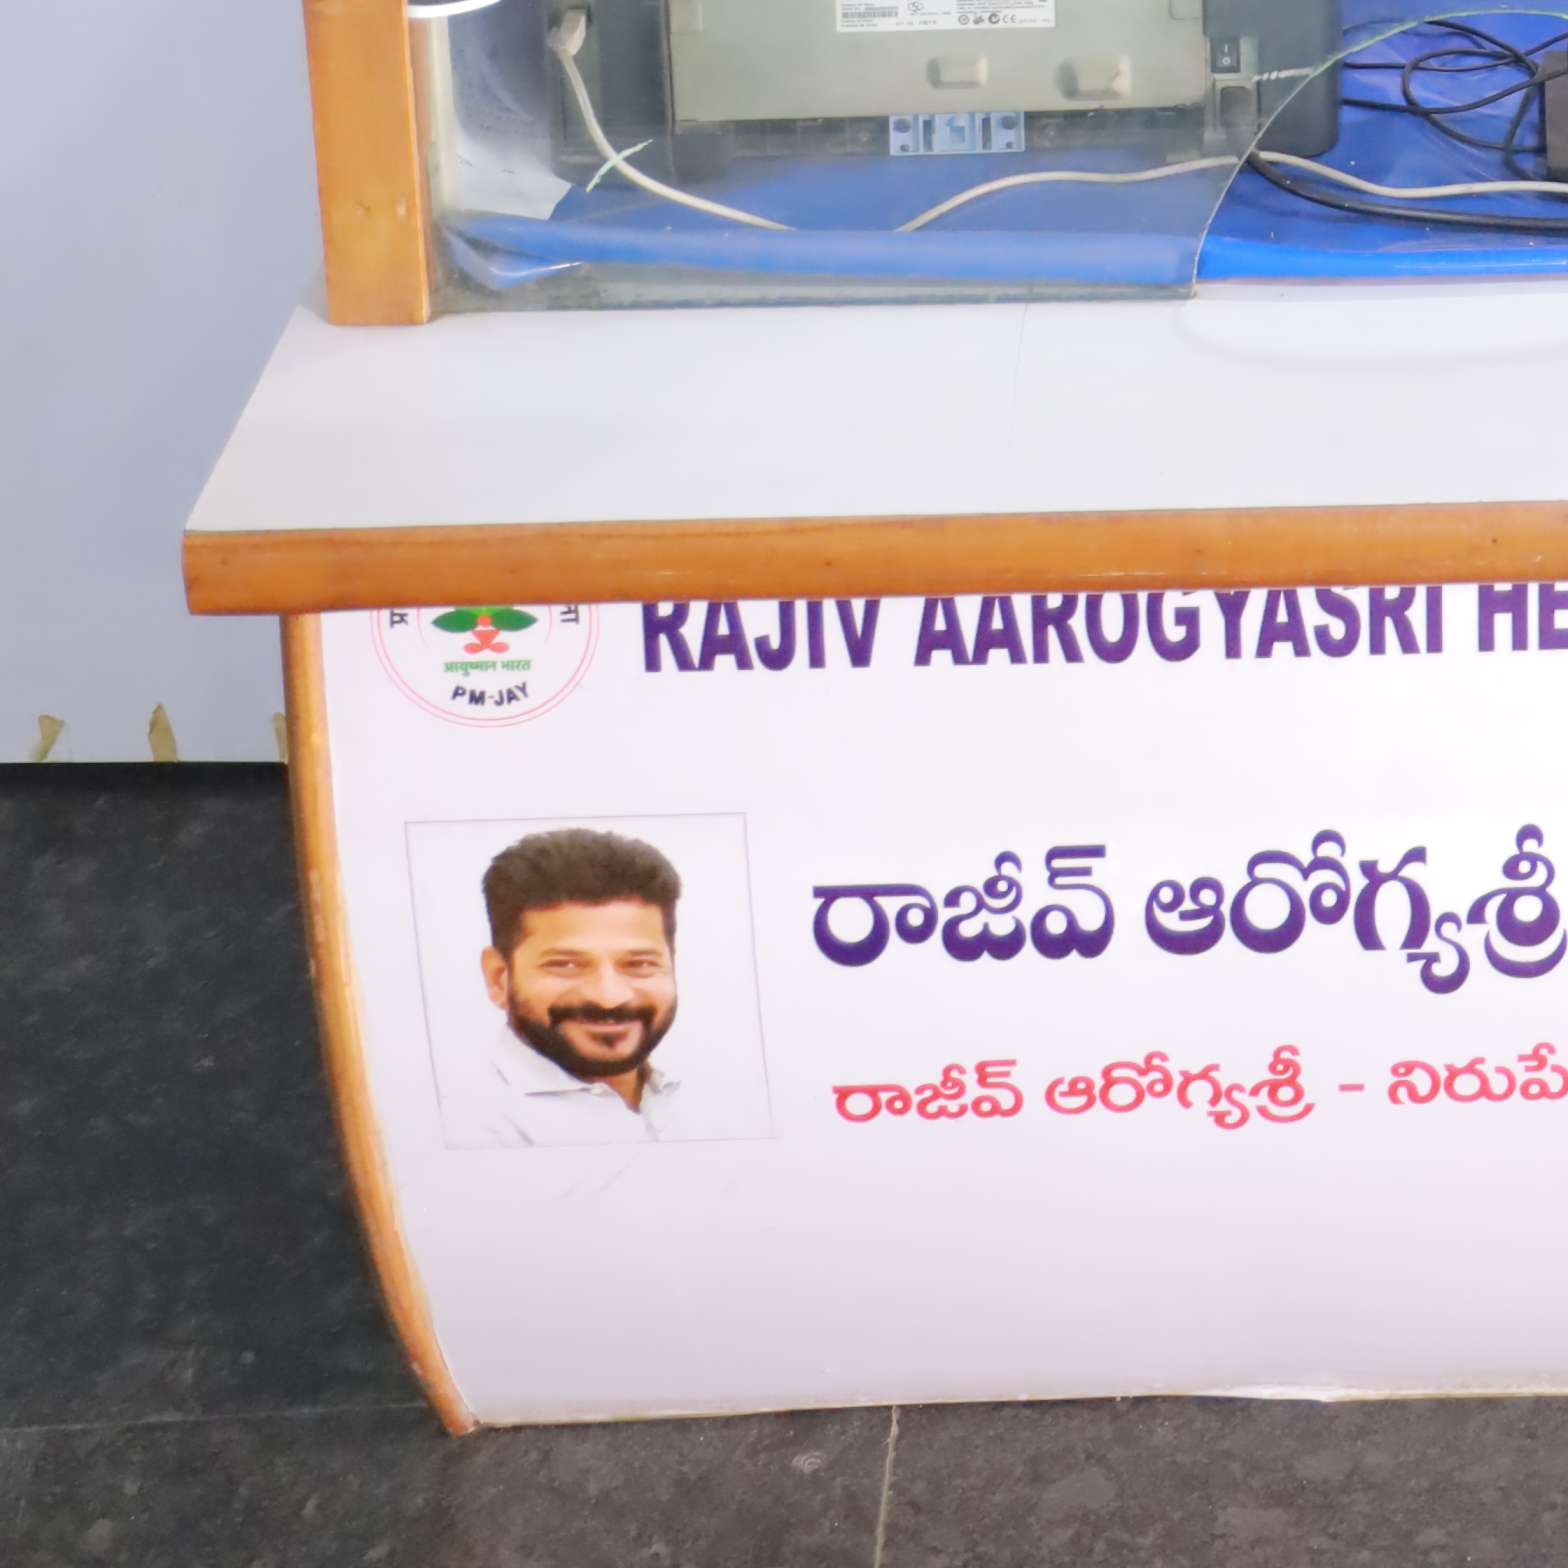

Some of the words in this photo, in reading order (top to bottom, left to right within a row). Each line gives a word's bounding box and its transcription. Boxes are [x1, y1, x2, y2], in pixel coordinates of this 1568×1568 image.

[644, 598, 880, 672] RAJIV
[914, 586, 1442, 667] AAROGYASRI
[452, 682, 528, 706] PM-JAY
[813, 845, 1114, 967] రాజీవ్
[1145, 824, 1567, 994] ఆరోగ్యశ్రీ
[832, 1060, 1023, 1122] రాజీవ్
[1045, 1045, 1314, 1130] ఆరోగ్యశ్రీ
